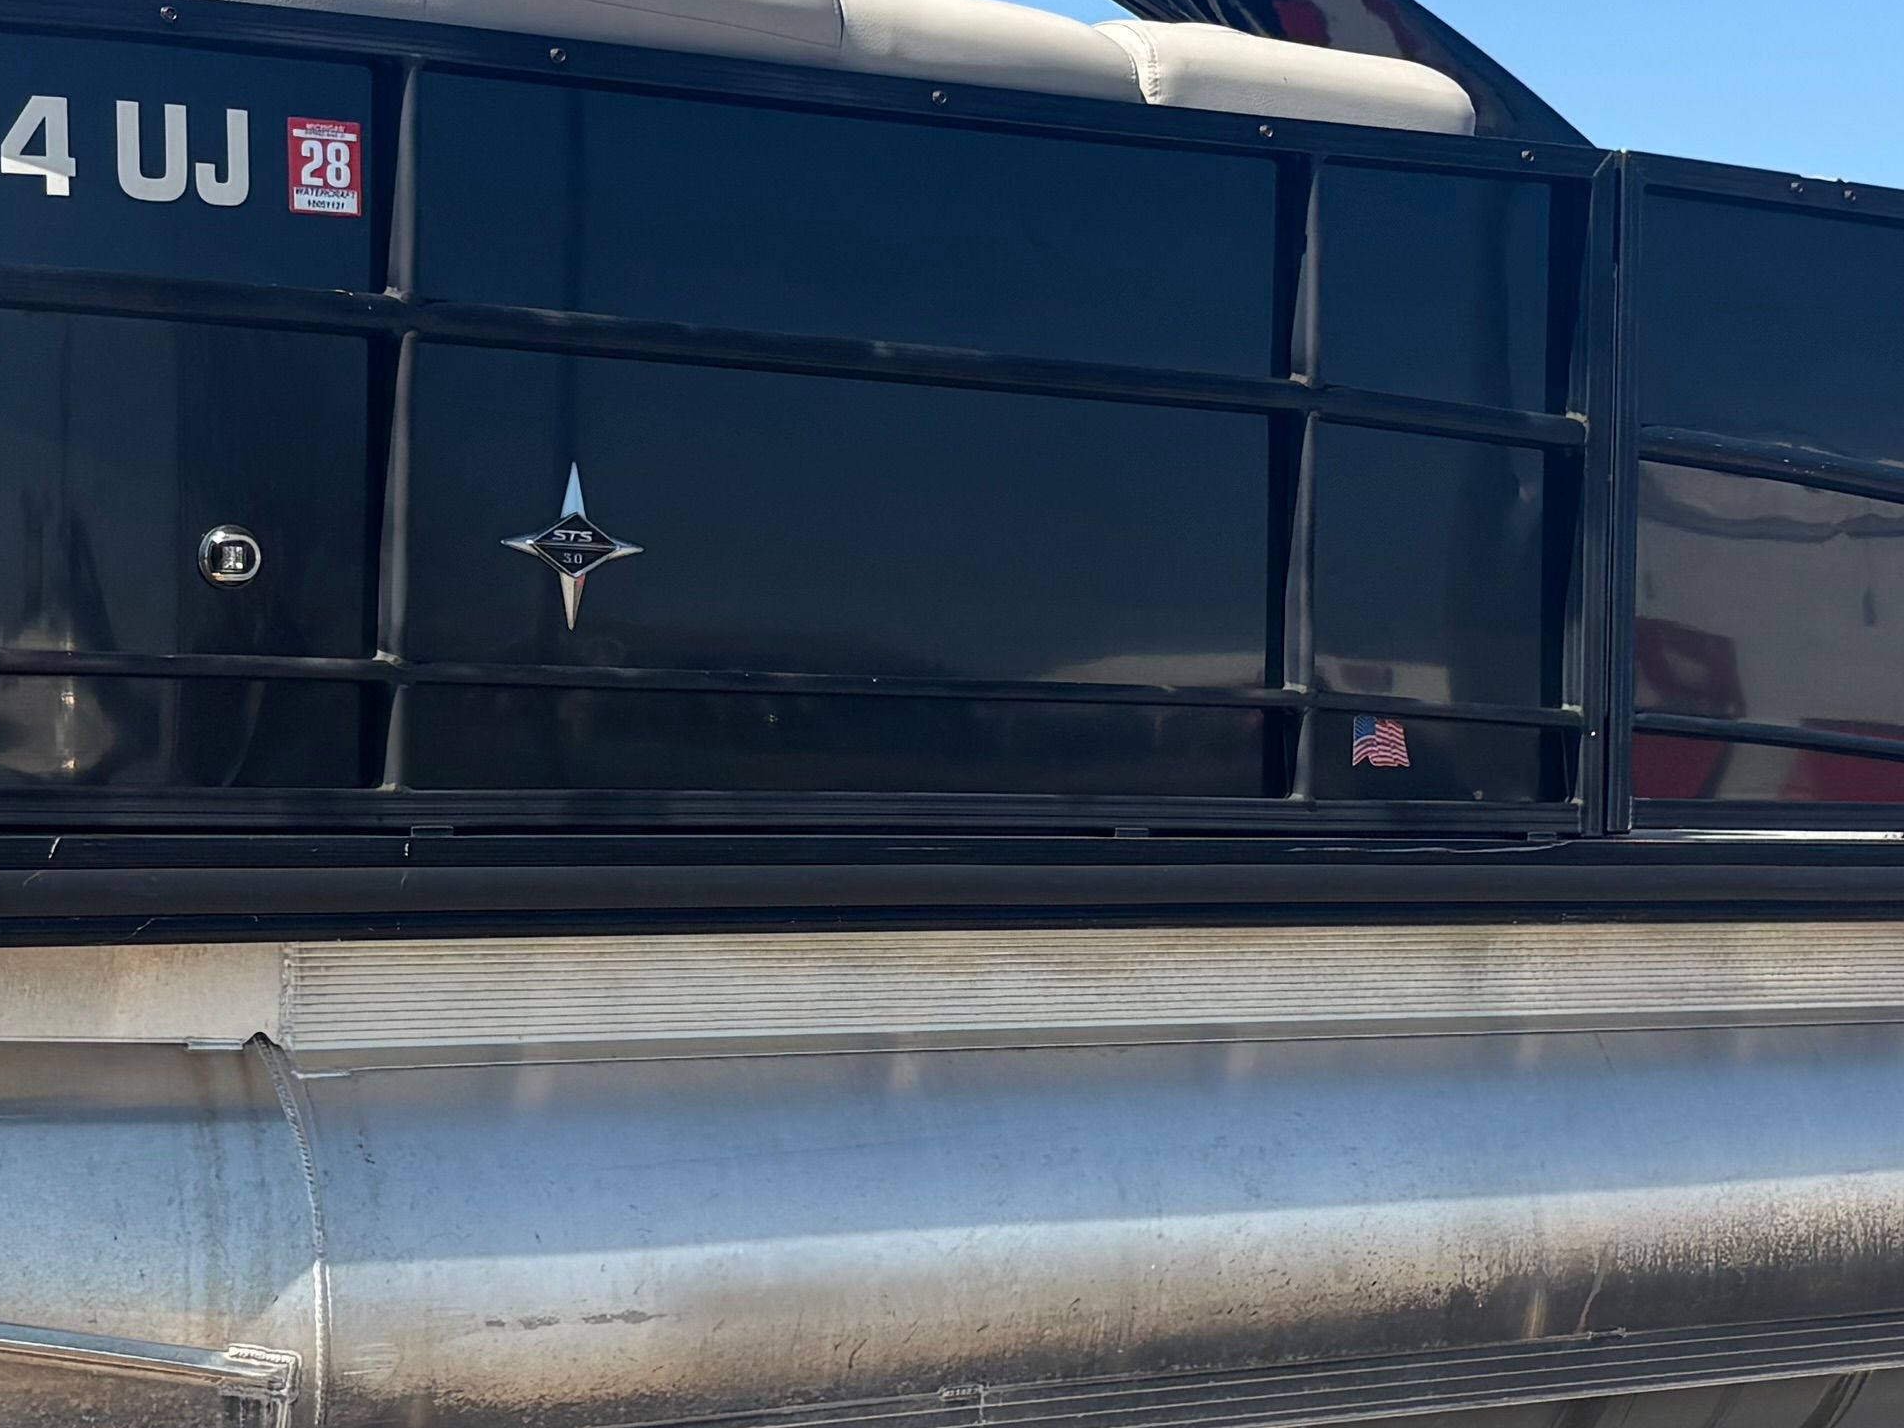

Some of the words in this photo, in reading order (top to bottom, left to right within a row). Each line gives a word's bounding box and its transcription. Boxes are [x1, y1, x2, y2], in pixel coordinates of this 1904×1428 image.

[115, 99, 250, 206] UJ
[301, 140, 351, 188] 28
[552, 529, 593, 543] STS
